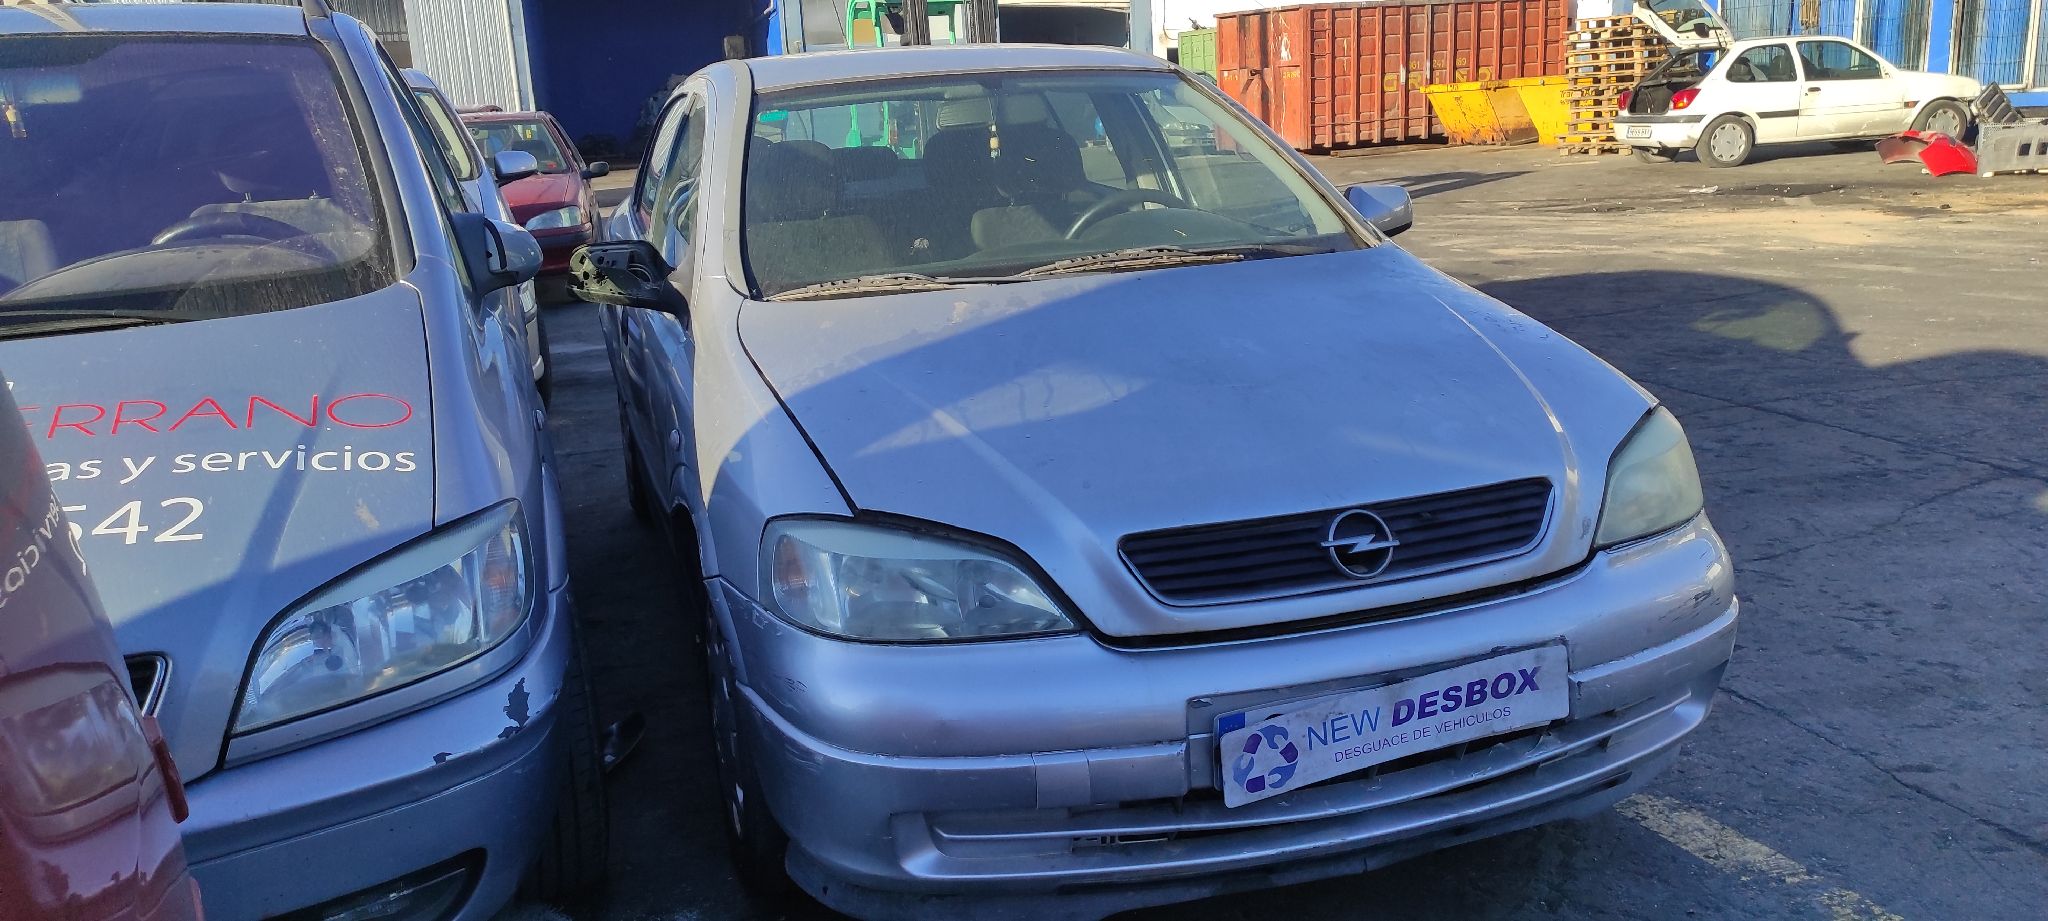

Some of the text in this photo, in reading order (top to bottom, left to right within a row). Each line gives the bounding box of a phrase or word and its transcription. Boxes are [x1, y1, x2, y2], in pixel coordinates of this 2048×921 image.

[16, 393, 413, 440] RRANO
[45, 444, 417, 485] as y servicios
[1307, 666, 1542, 751] NEW DESBOX
[1334, 706, 1512, 763] DESGUACE DE VEHICULOS
